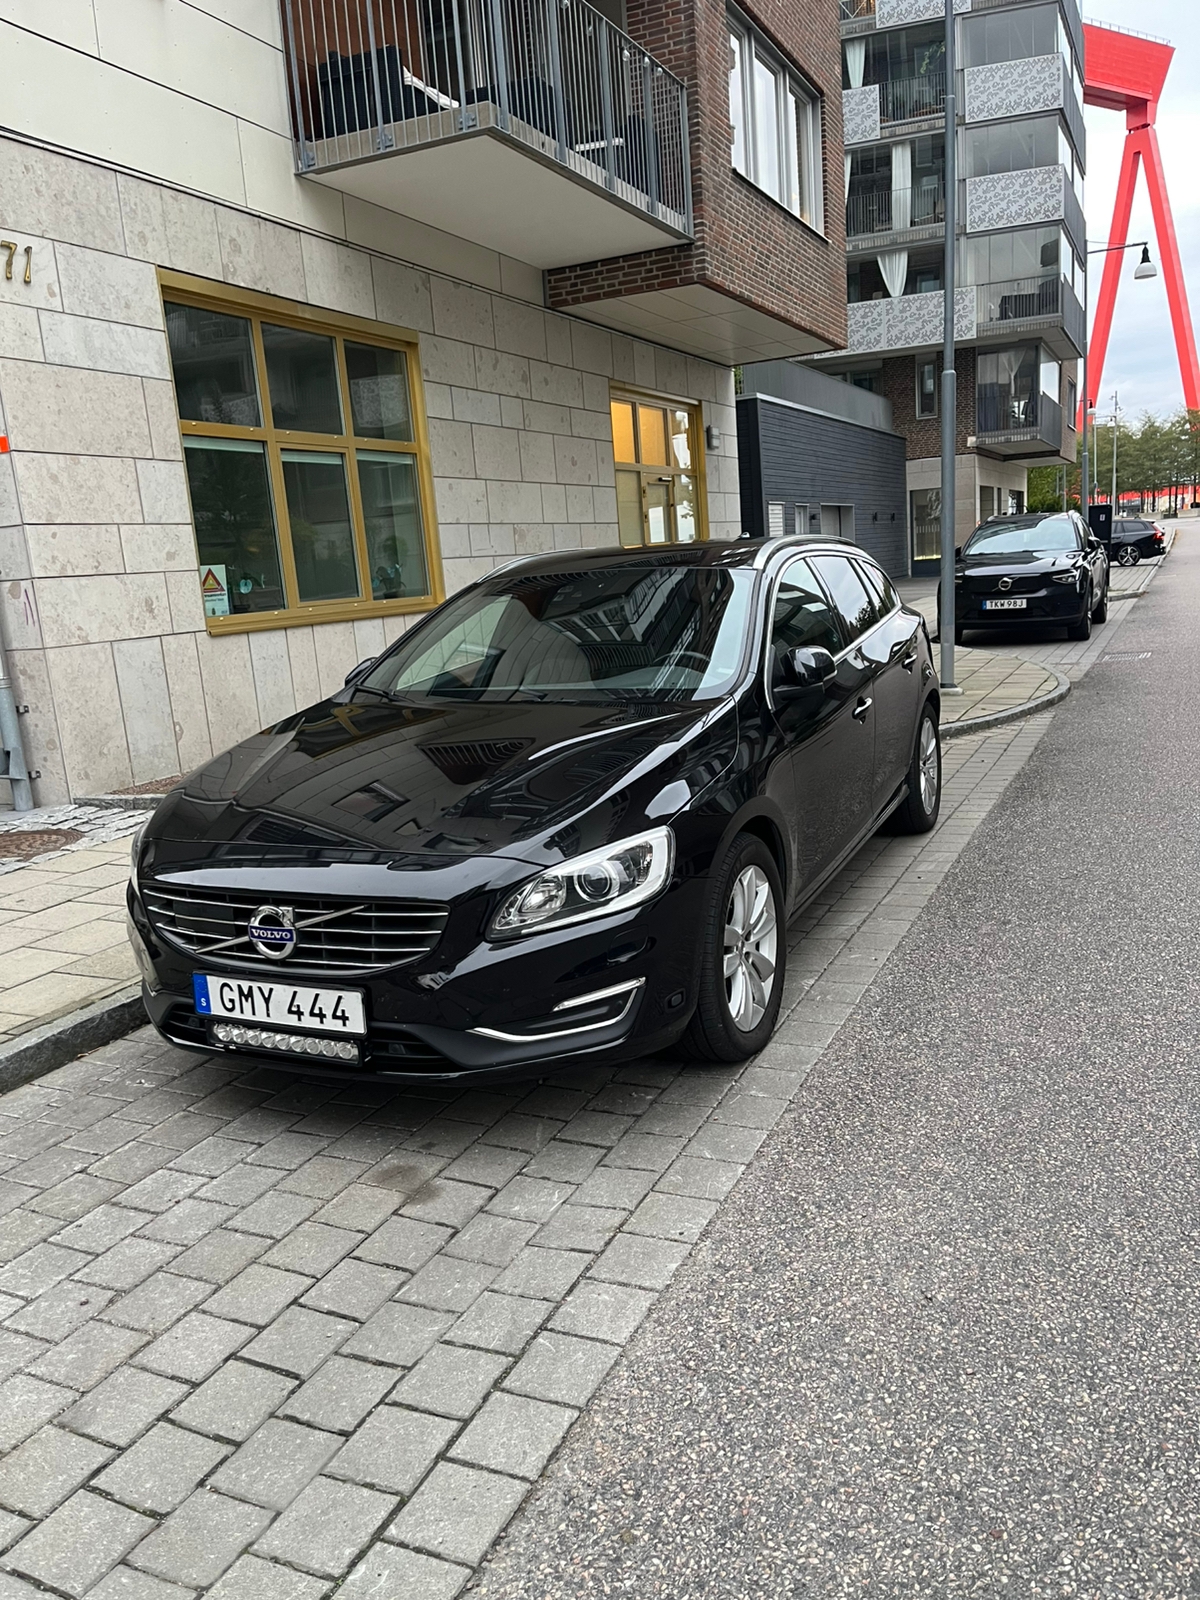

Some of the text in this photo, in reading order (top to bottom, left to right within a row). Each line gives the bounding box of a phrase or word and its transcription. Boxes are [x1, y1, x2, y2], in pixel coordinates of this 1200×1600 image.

[1, 240, 32, 283] 71
[990, 600, 1023, 608] TKW 98J
[251, 928, 291, 939] VOLVO
[200, 997, 207, 1007] S
[219, 982, 350, 1027] GMY 444
